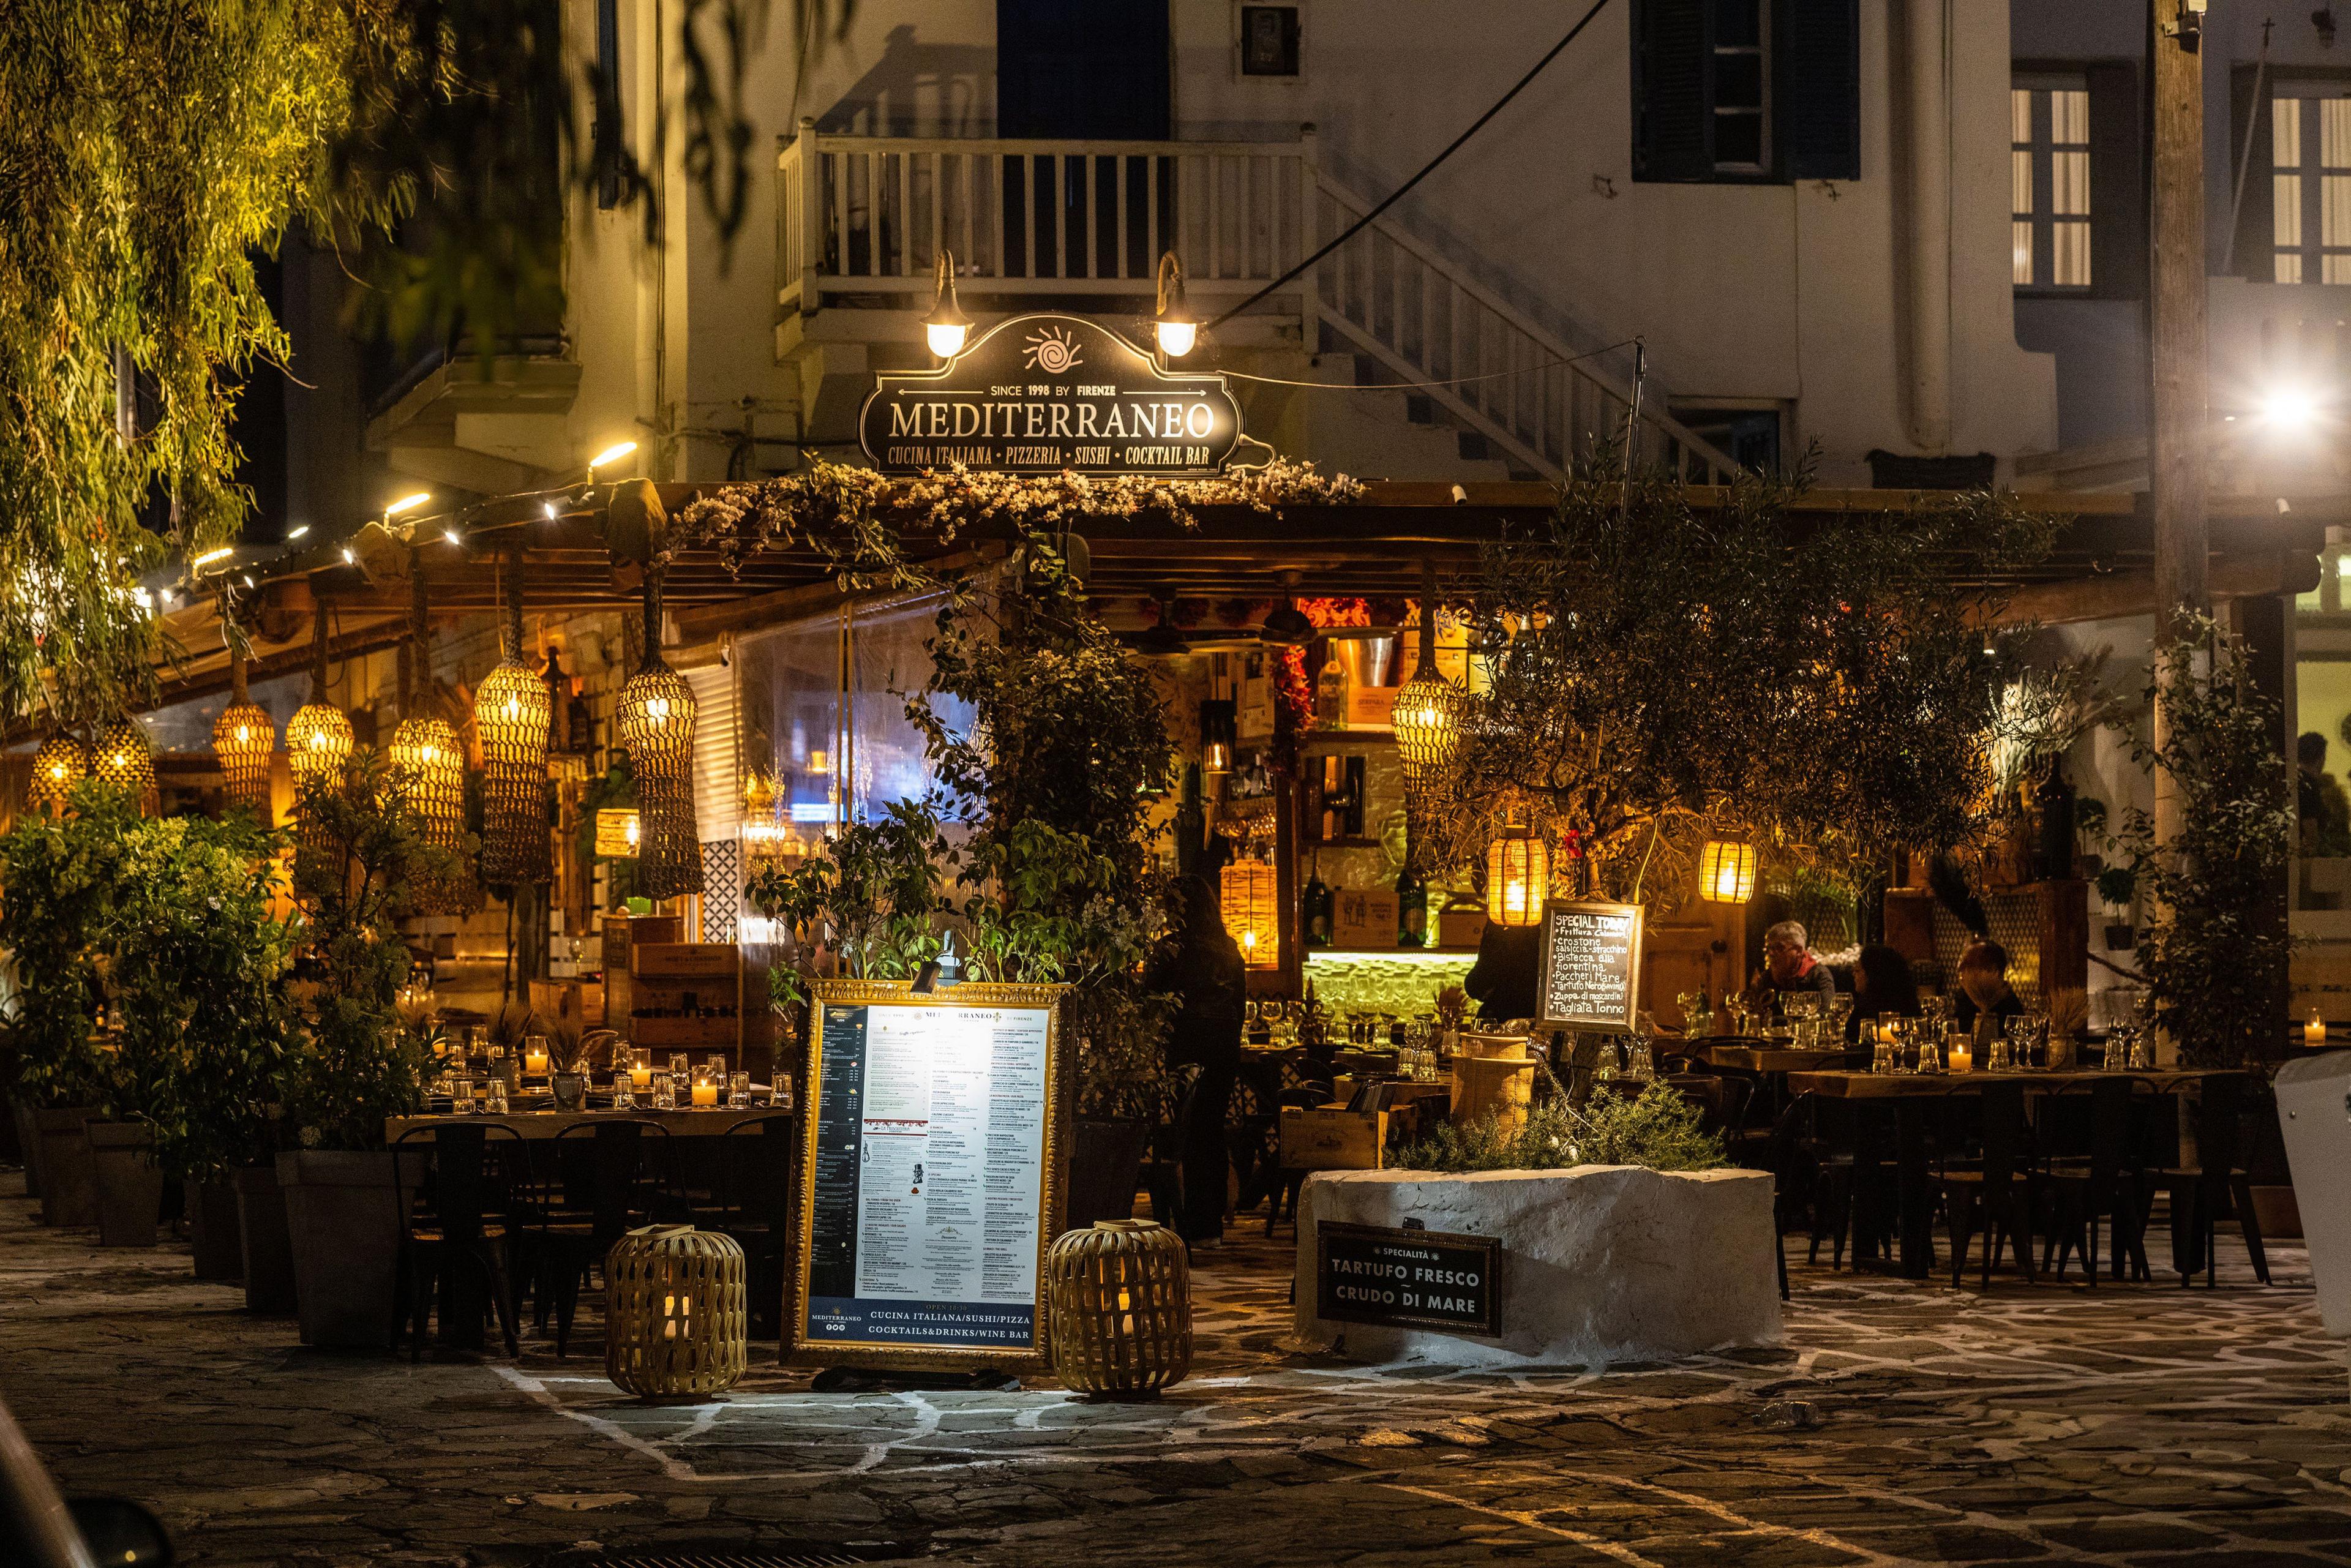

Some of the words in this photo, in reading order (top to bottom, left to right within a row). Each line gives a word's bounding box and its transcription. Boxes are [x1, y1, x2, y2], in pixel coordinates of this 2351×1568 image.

[991, 386, 1021, 396] SINCE
[1028, 385, 1049, 396] 1998
[1056, 386, 1069, 396] BY
[1077, 385, 1116, 396] FIRENZE
[889, 402, 1214, 438] MEDITERRANEO
[888, 447, 932, 465] CUCINA
[936, 447, 991, 464] ITALIANA
[1005, 447, 1061, 464] PIZZERIA
[1074, 447, 1110, 465] SUSHI
[1125, 447, 1182, 465] COCKTAIL
[1185, 447, 1209, 465] BAR
[1556, 915, 1595, 929] SPECIAL
[1596, 917, 1629, 931] TODAY
[1560, 926, 1592, 936] Frittura
[1558, 953, 1594, 961] Bistecca
[1599, 954, 1614, 963] alla
[1556, 962, 1607, 972] fiorentina
[1556, 971, 1592, 981] Paccheri
[1595, 972, 1620, 982] Mare
[1554, 980, 1584, 990] Tartufo
[1554, 992, 1580, 1002] Zuppa
[1581, 991, 1588, 1000] di
[1553, 1000, 1593, 1015] Tagliata
[1594, 1000, 1624, 1013] Tonno
[1384, 1248, 1428, 1259] SPECIALITÀ
[1332, 1259, 1407, 1278] TARTUFO
[1415, 1268, 1479, 1286] FRESCO
[1337, 1286, 1394, 1304] CRUDO
[1403, 1293, 1419, 1307] DI
[1428, 1296, 1475, 1313] MARE
[913, 1313, 1030, 1324] ITALIANA/SUSHI/PIZZA
[868, 1326, 1005, 1338] COCKTAILS&DRINKS/WINE
